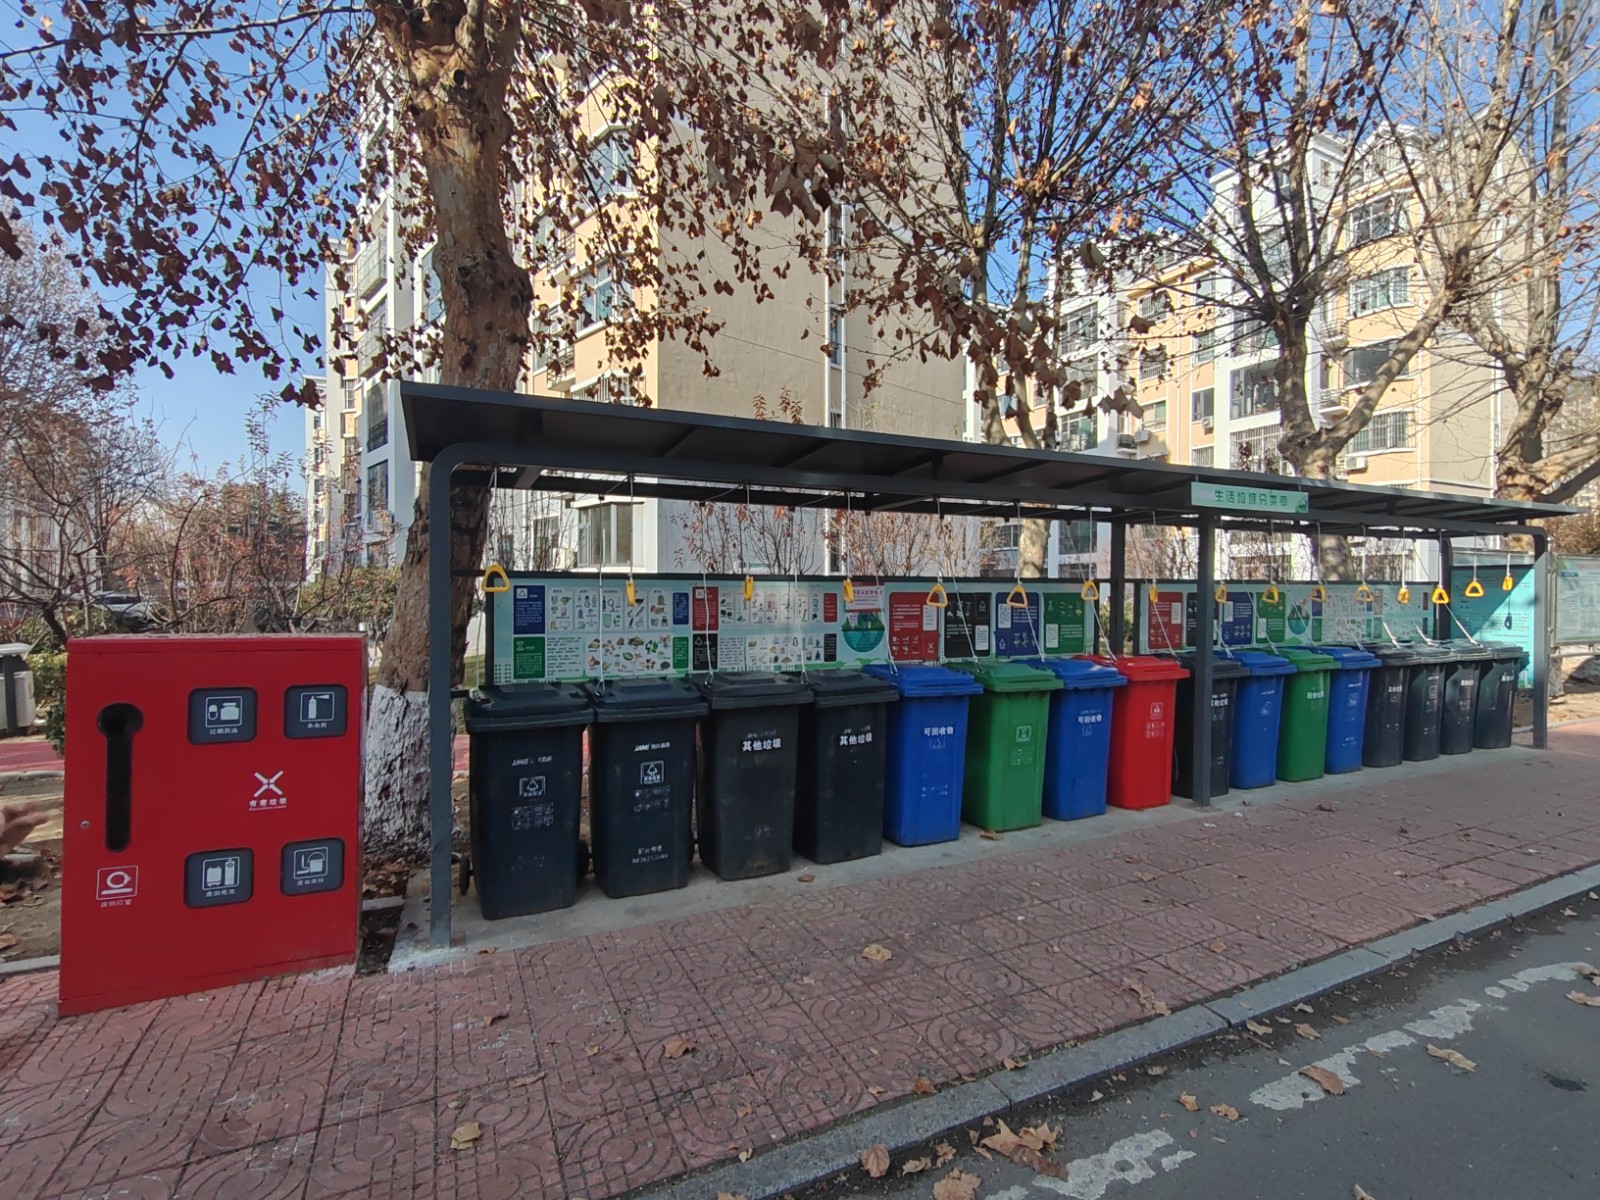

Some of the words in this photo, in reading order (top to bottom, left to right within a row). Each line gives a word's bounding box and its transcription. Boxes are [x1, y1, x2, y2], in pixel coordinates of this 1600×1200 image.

[923, 726, 954, 737] 可回收物
[741, 737, 782, 752] 其他垃圾
[839, 732, 873, 747] 其他垃圾
[249, 797, 287, 807] 有害垃圾
